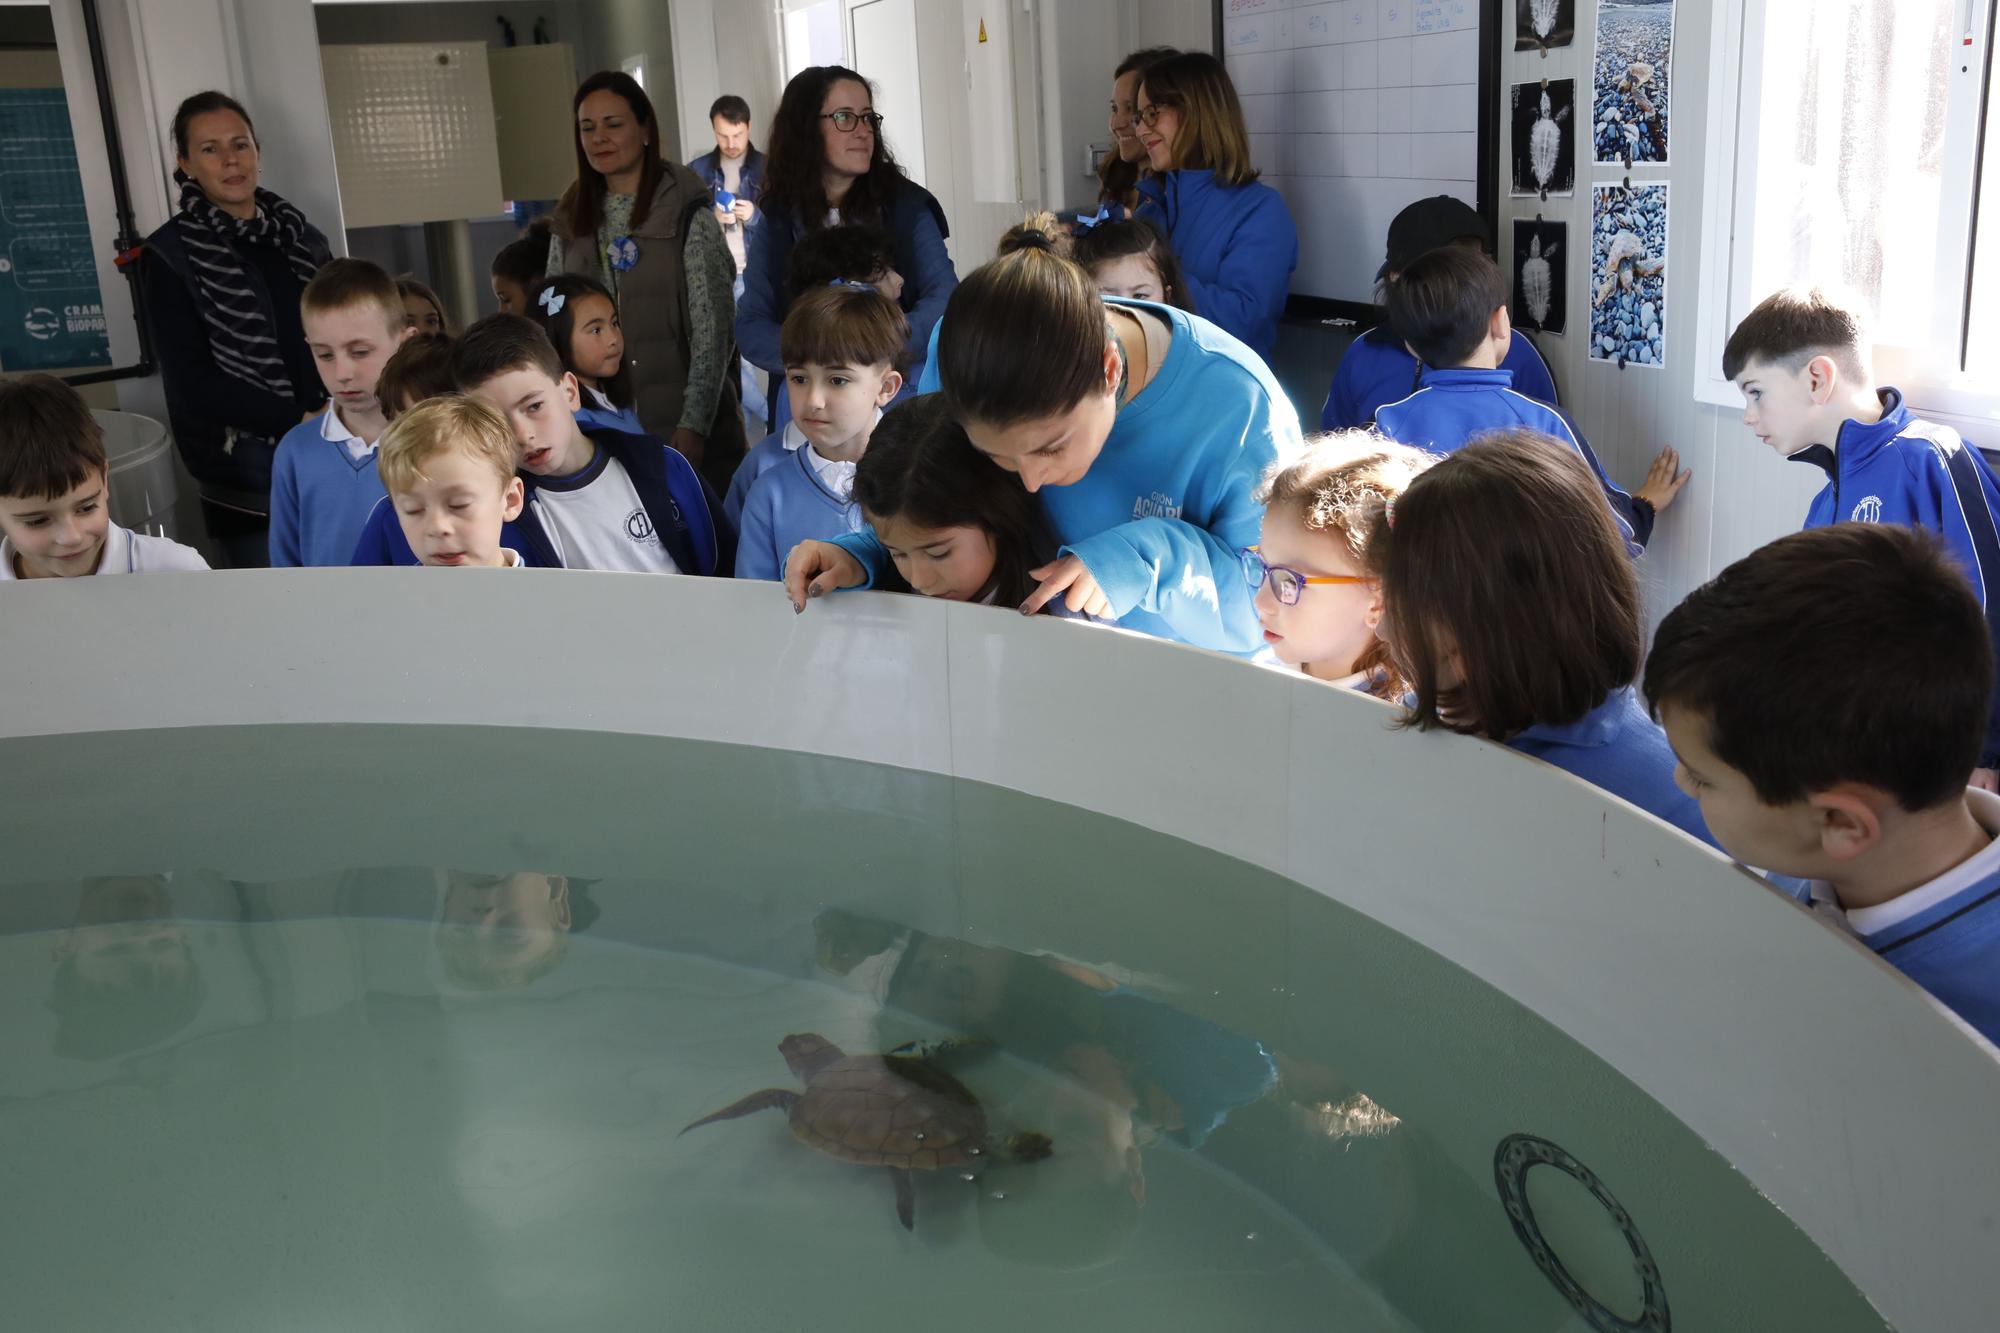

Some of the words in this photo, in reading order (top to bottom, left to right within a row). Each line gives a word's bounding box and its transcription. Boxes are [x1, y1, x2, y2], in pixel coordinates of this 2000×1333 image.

[64, 304, 103, 316] CRAM
[66, 318, 106, 333] BiOPAR
[1133, 496, 1183, 518] ACUARI
